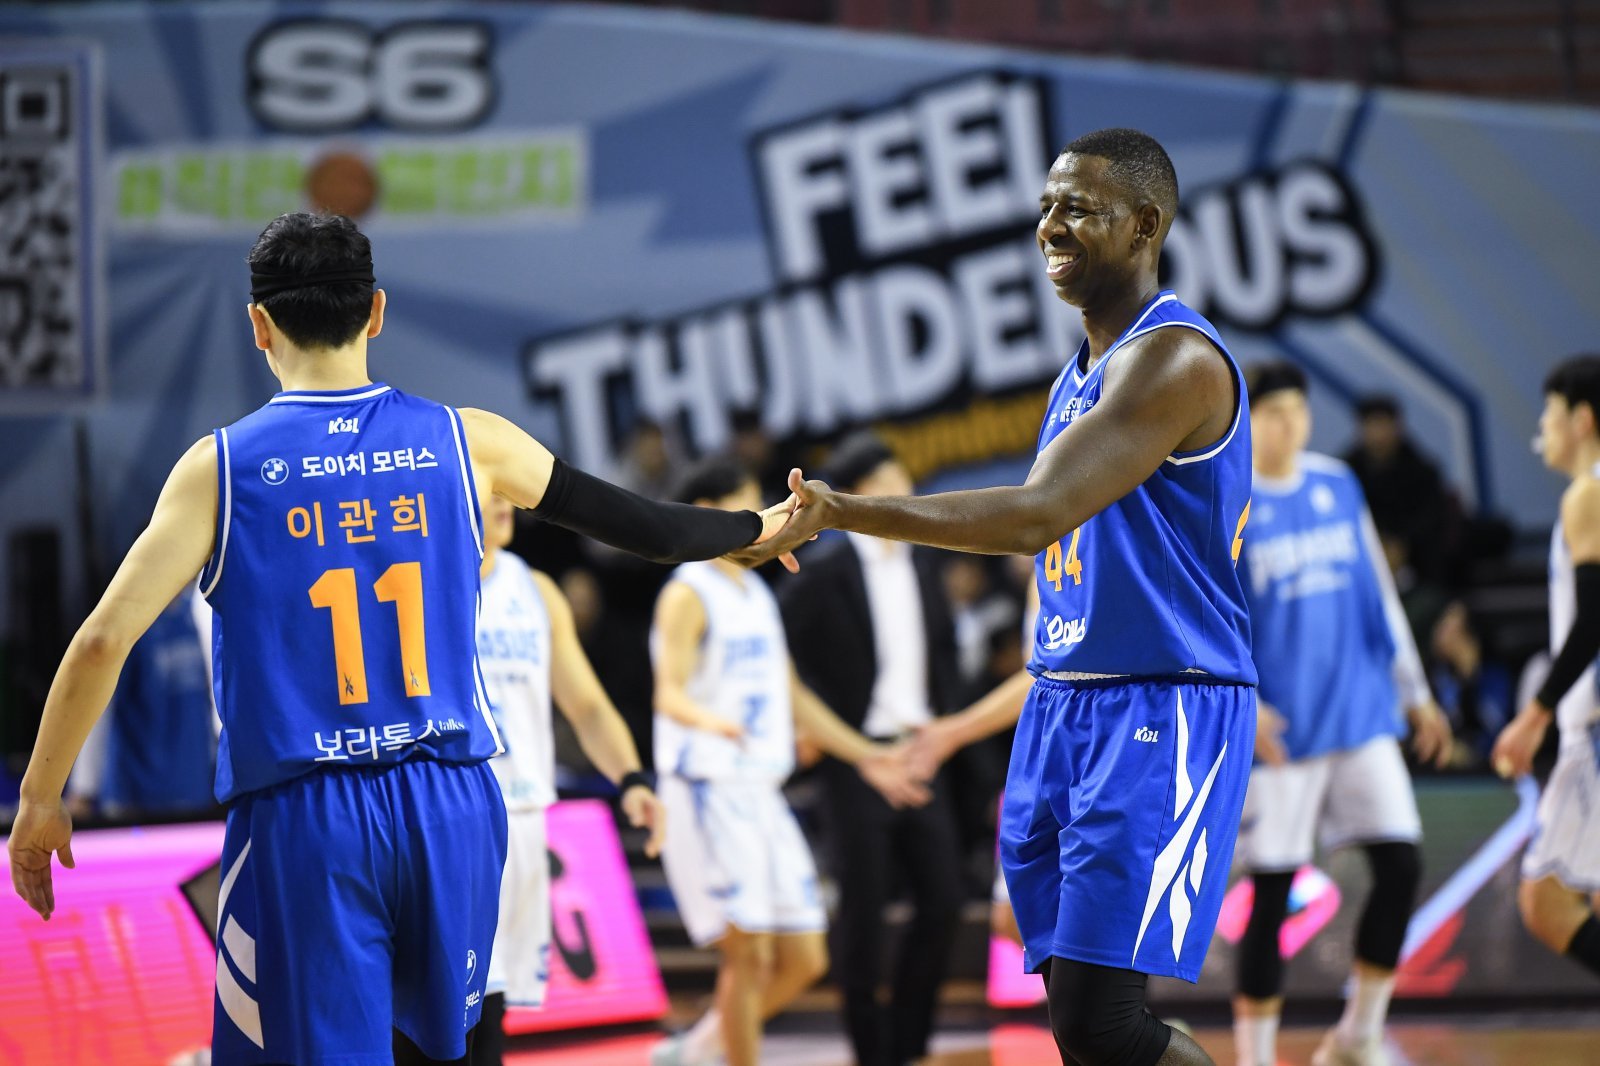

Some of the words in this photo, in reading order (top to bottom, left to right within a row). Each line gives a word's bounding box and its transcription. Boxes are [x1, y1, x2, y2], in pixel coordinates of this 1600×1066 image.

[249, 21, 493, 129] S6
[752, 75, 1052, 282] FEEL
[328, 417, 360, 435] KBL
[301, 452, 367, 478] 도이치
[372, 447, 438, 473] 모터스
[287, 493, 428, 546] 이관희
[1045, 526, 1082, 592] 44
[308, 561, 432, 705] 11
[1133, 726, 1159, 743] KBL
